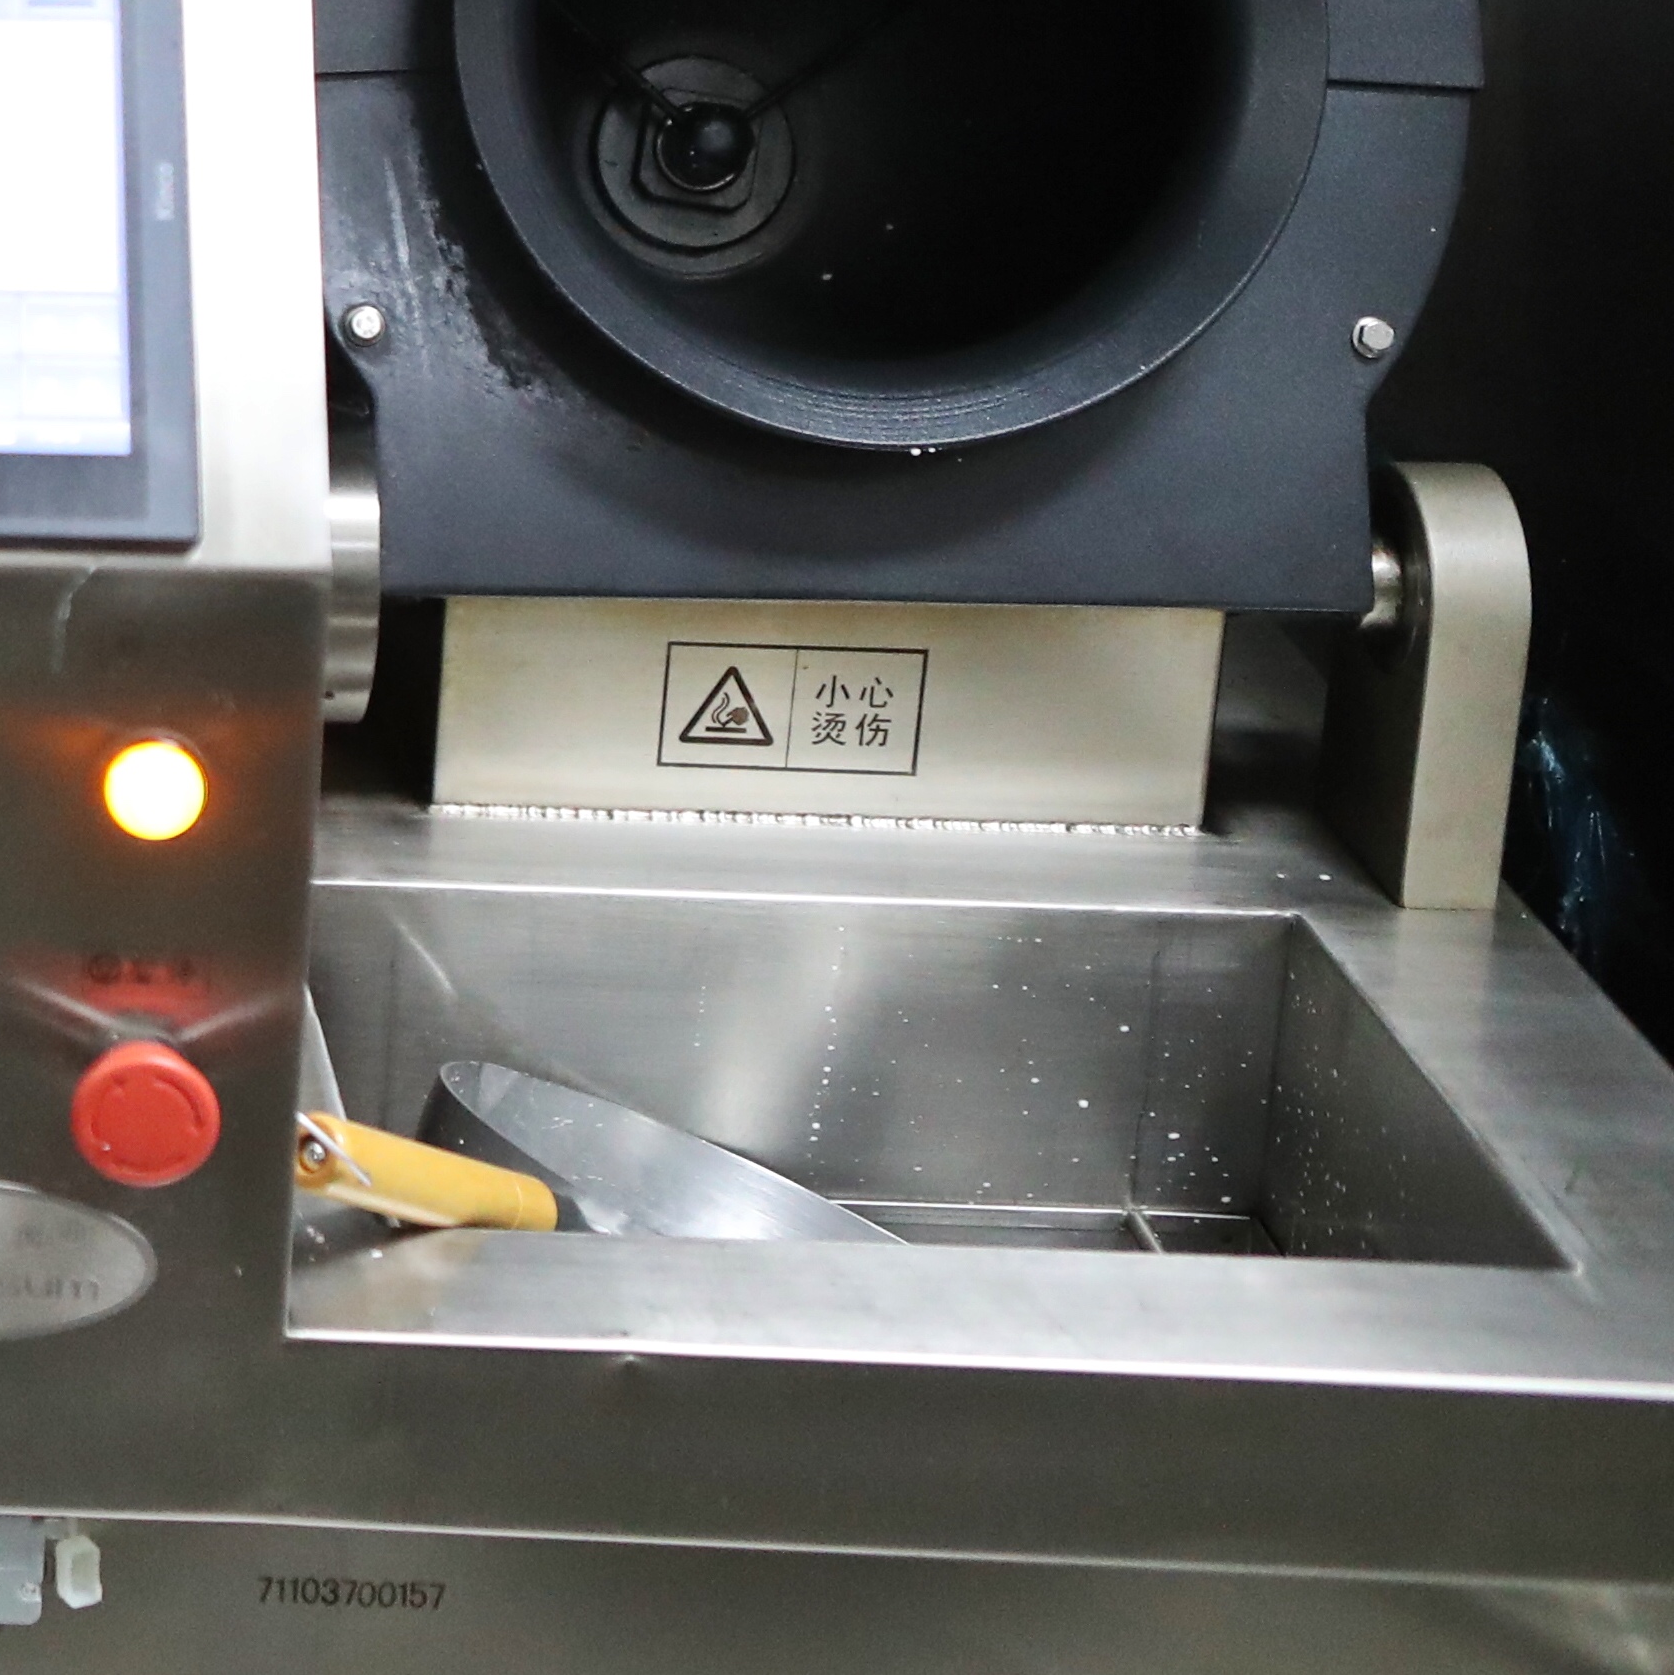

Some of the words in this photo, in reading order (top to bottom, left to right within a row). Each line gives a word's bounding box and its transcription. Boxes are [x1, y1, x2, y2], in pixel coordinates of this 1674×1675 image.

[815, 675, 894, 710] 小心
[810, 711, 892, 749] 烫伤
[257, 1576, 447, 1611] 71103700157
